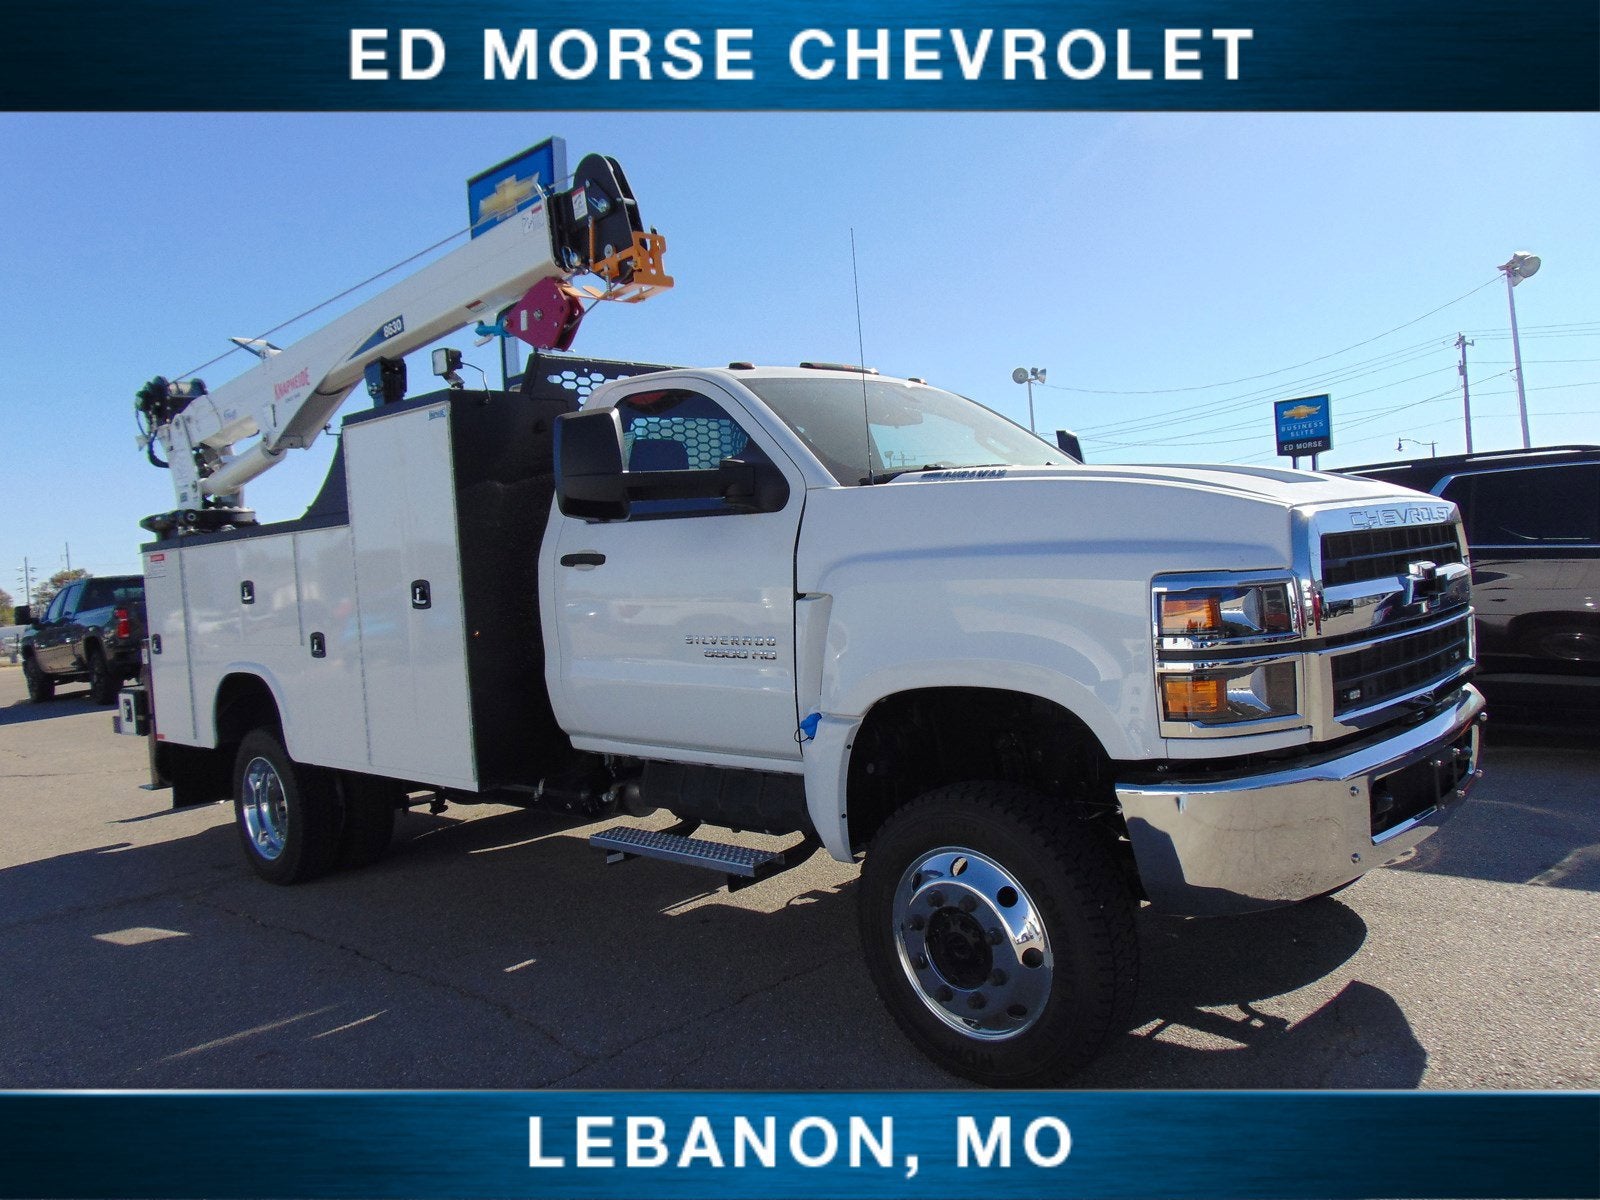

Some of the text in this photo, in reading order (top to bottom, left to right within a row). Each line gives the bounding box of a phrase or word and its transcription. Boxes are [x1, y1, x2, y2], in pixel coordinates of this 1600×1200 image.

[384, 319, 402, 338] 8630
[1281, 421, 1324, 432] BUSINESS
[1290, 429, 1315, 437] ELITE
[1296, 440, 1323, 450] MORSE
[1349, 507, 1449, 528] CHEVROLET
[685, 635, 776, 647] SILVERADO
